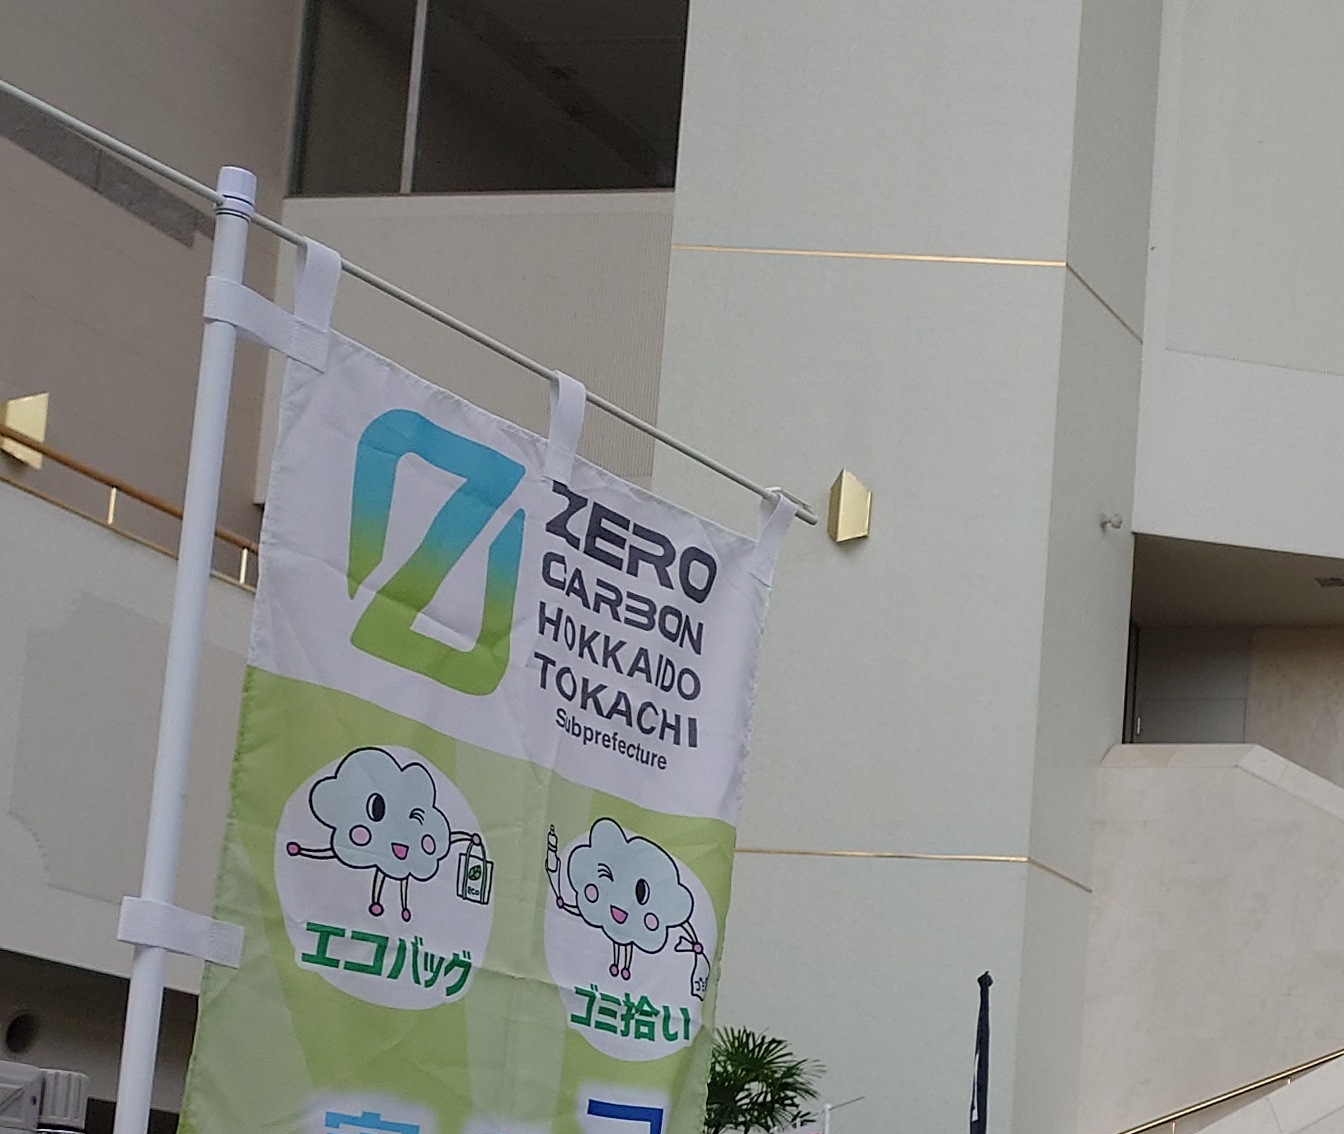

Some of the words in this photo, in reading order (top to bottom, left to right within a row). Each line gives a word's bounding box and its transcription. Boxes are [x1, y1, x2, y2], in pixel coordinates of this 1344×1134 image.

[544, 481, 718, 604] ZERO
[537, 600, 701, 701] HOKKAIDO
[541, 552, 703, 655] CARBON
[533, 652, 699, 748] TOKACHI
[555, 708, 668, 770] Subprefecture
[301, 921, 472, 997] エコバッグ
[570, 983, 691, 1042] ゴミ拾い
